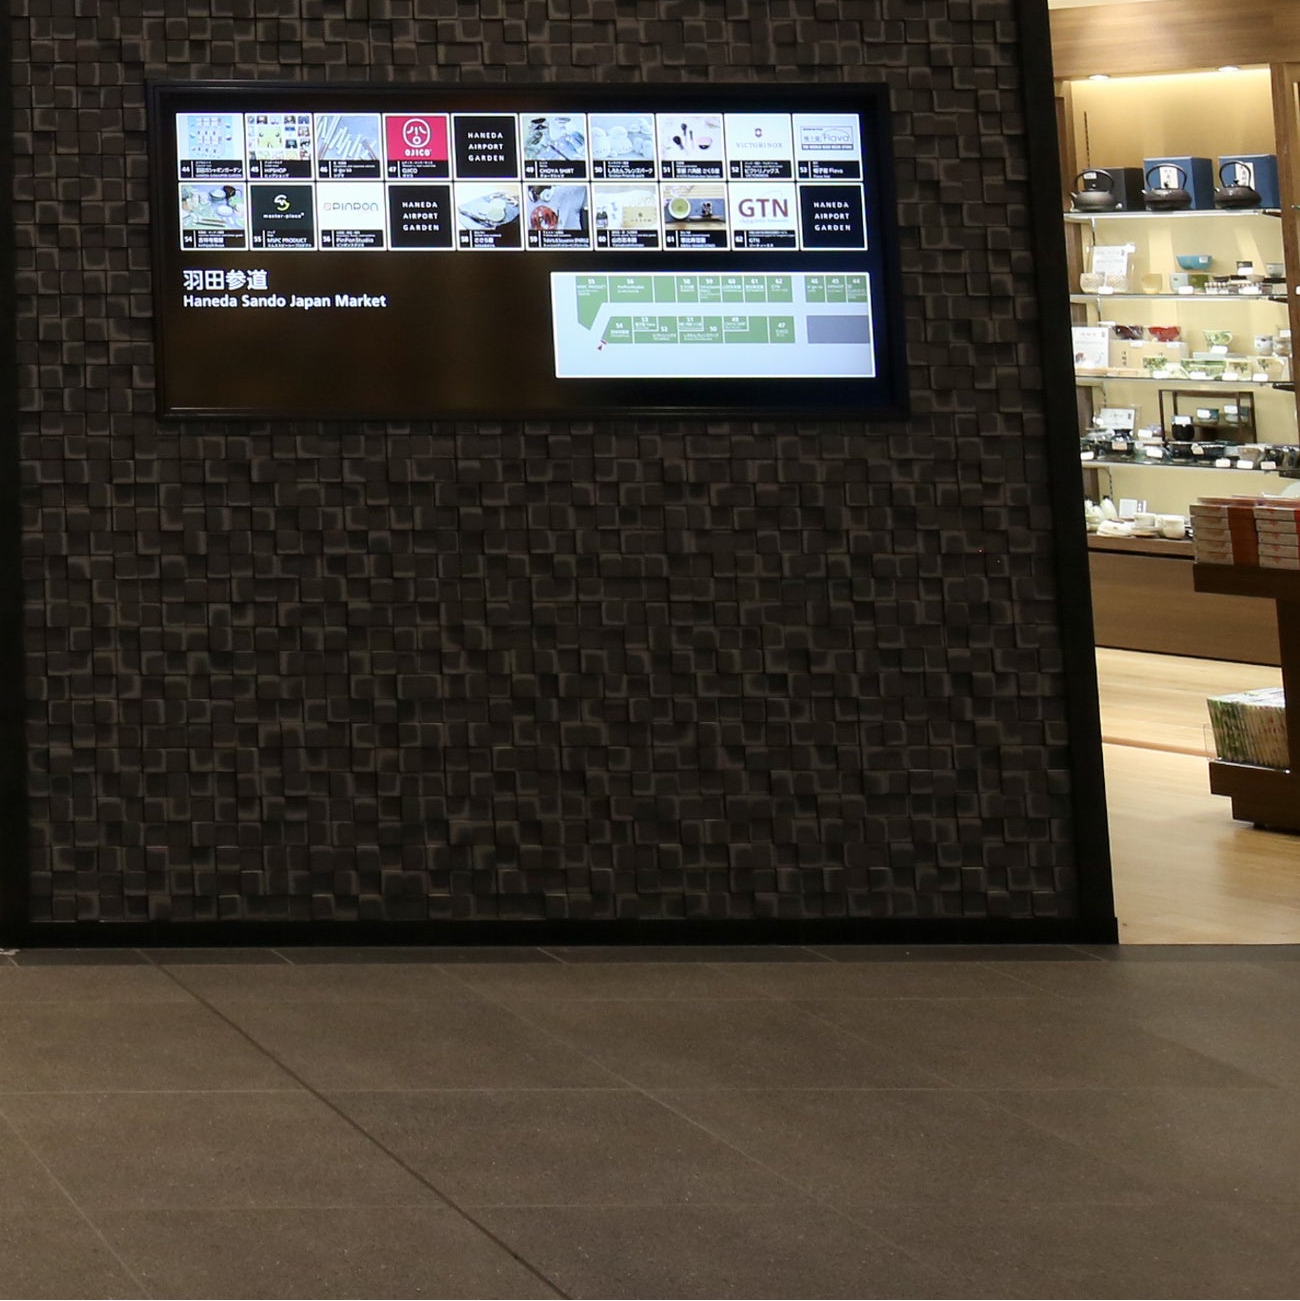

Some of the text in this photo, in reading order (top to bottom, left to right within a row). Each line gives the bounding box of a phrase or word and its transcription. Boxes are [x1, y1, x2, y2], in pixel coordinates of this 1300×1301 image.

[405, 149, 430, 157] OJICO
[469, 154, 505, 162] GARDEN
[738, 198, 789, 218] GTN
[182, 269, 268, 290] 羽田参道
[183, 294, 387, 310] Haneda Sando Japan Market
